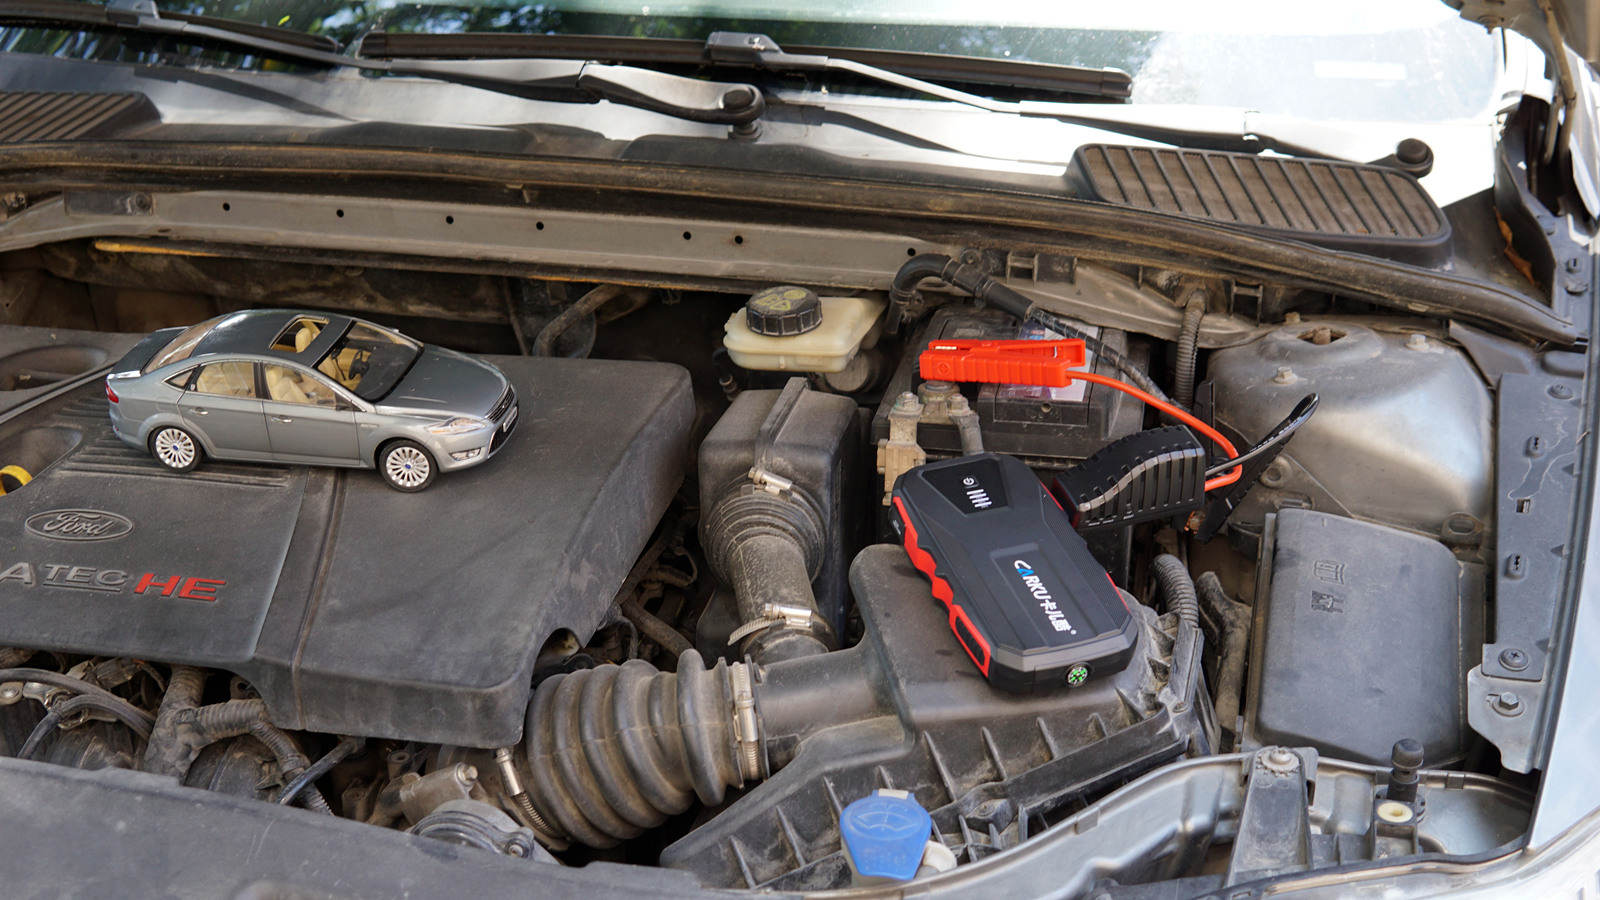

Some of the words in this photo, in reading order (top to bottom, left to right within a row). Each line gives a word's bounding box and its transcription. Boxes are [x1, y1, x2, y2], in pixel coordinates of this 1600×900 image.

[43, 512, 114, 536] Ford
[134, 573, 227, 602] HE
[1014, 560, 1052, 600] CARKU
